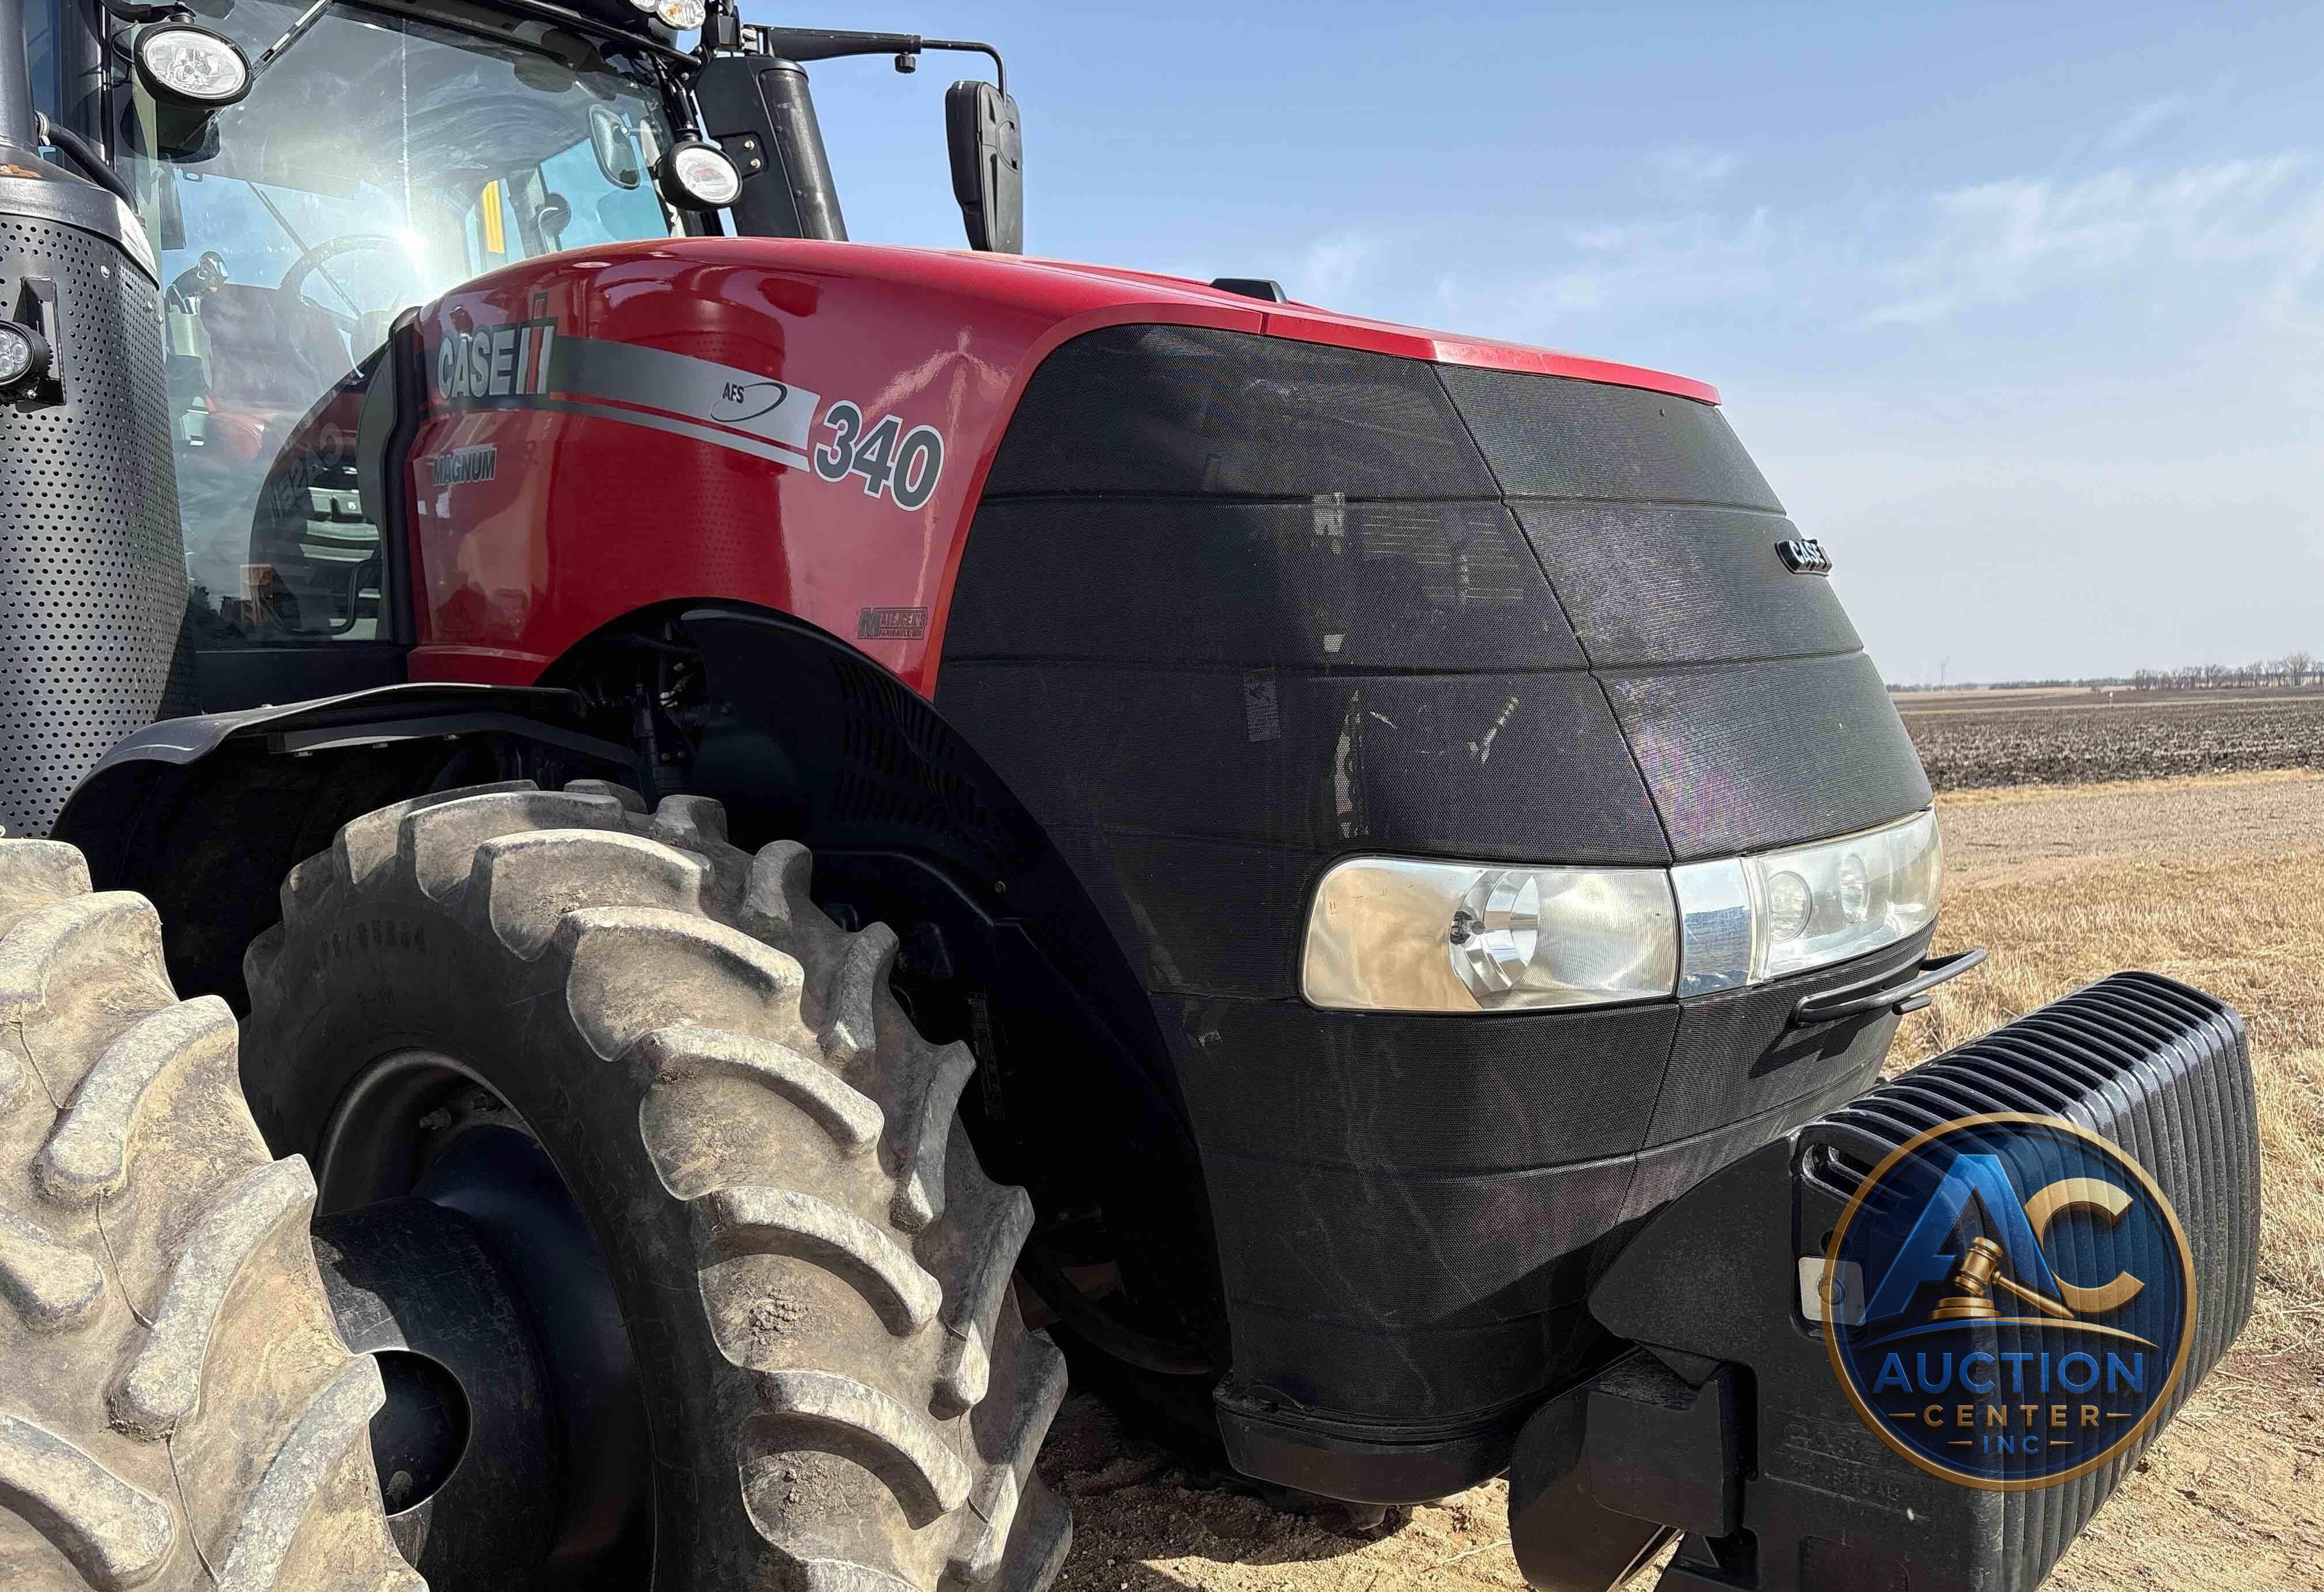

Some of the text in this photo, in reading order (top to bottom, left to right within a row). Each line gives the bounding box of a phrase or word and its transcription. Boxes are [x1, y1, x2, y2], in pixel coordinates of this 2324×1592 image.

[438, 330, 515, 400] CASE
[723, 383, 745, 403] AFS
[433, 450, 497, 485] MAGNUM
[814, 400, 944, 511] 340
